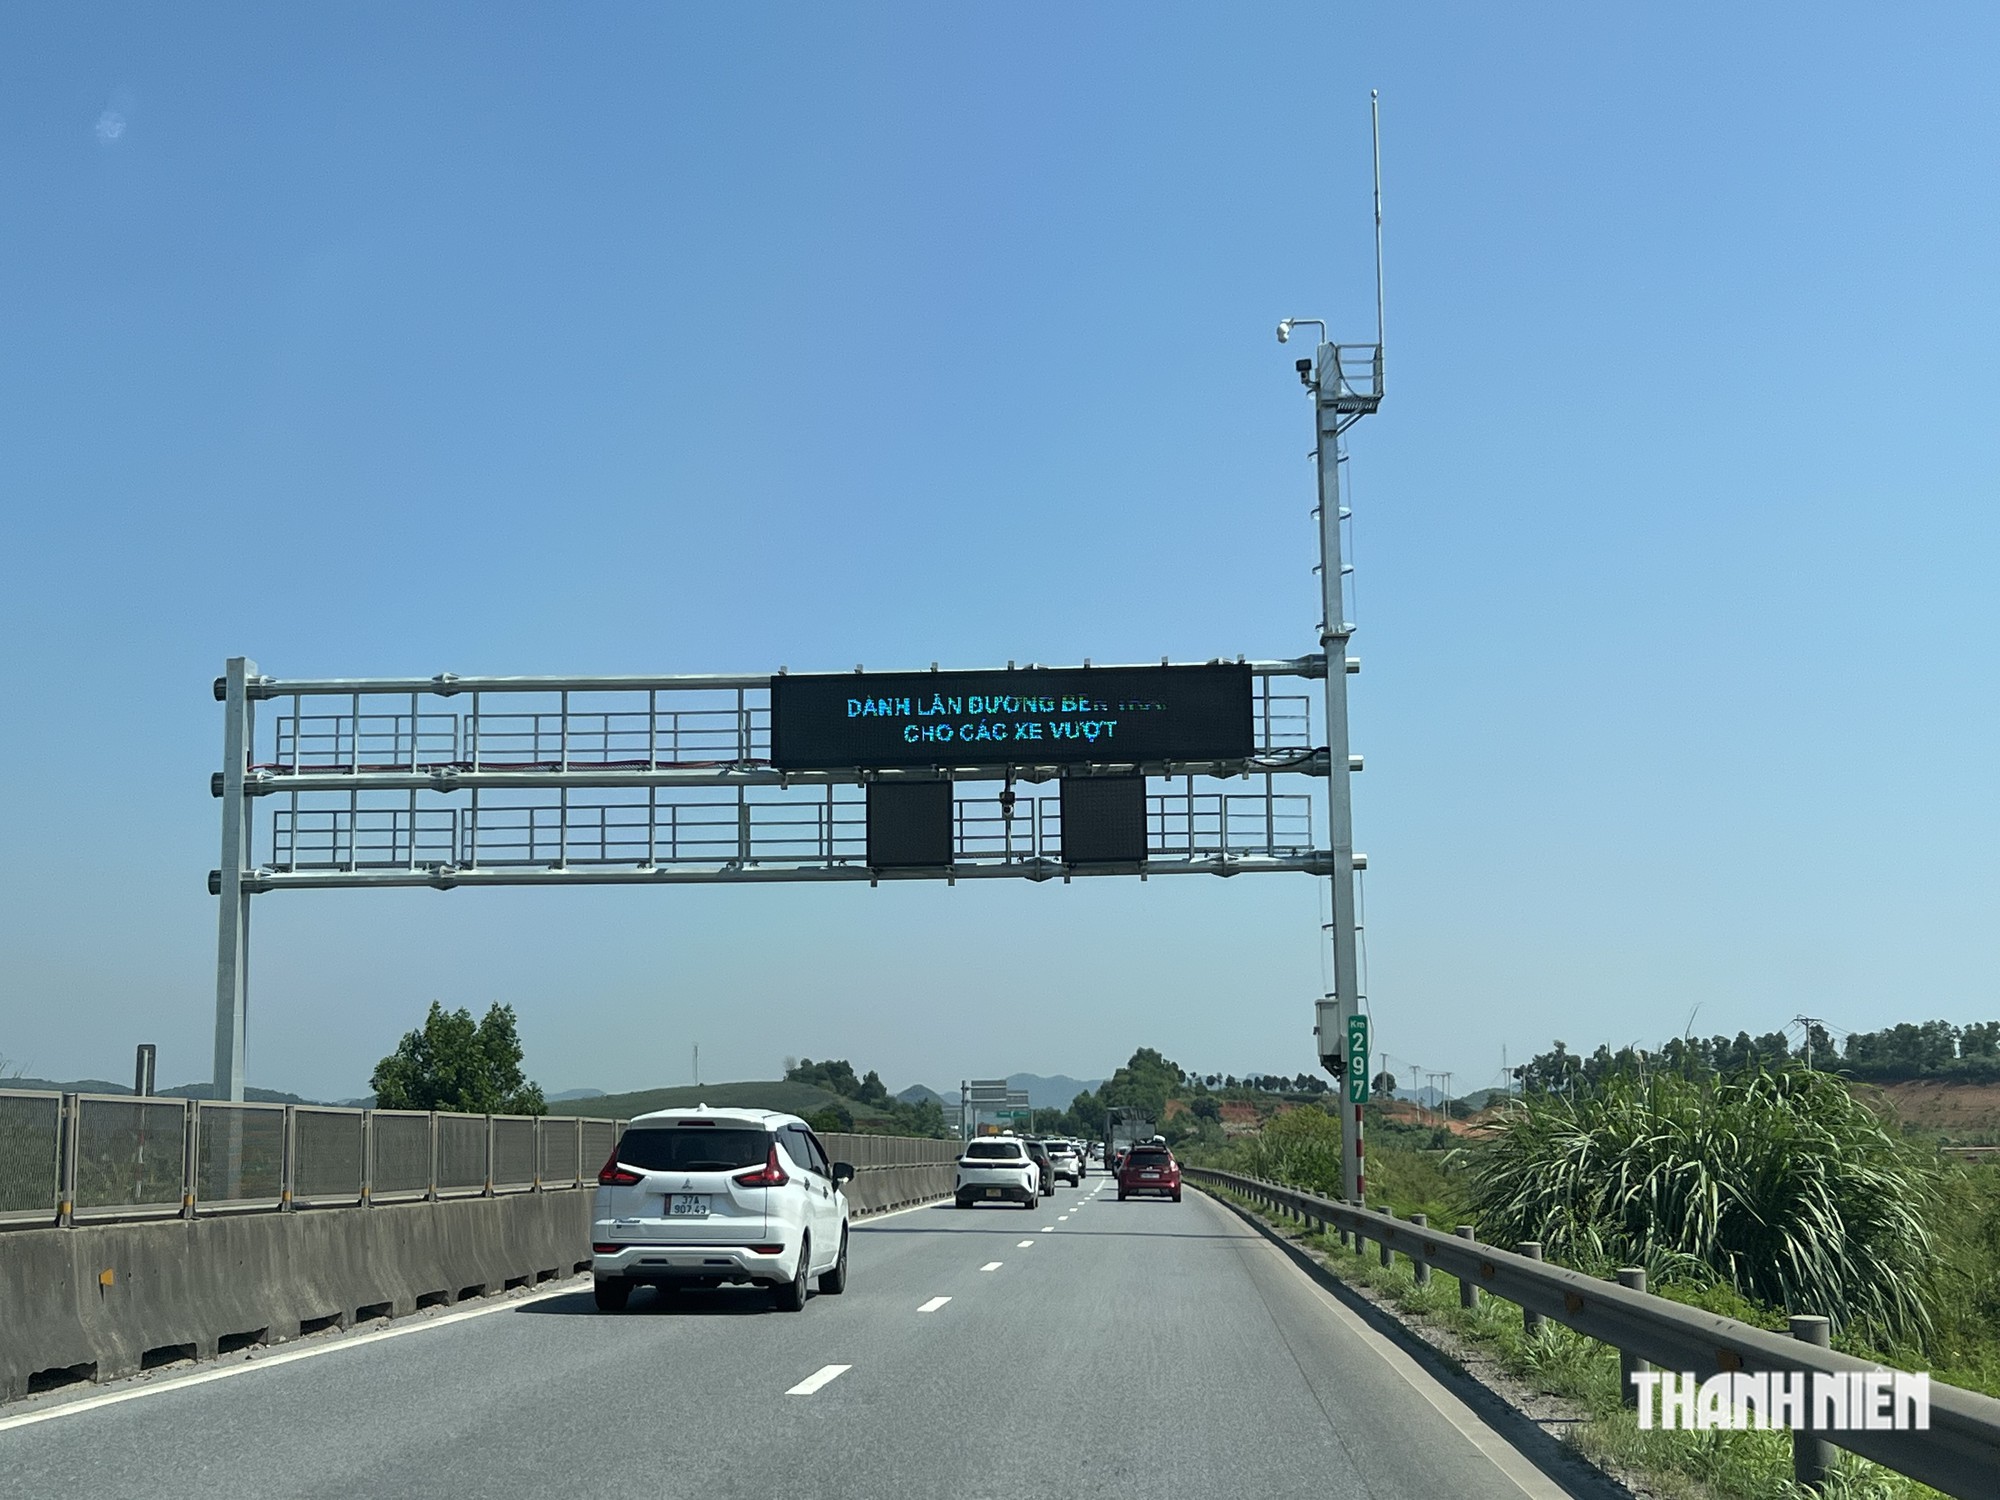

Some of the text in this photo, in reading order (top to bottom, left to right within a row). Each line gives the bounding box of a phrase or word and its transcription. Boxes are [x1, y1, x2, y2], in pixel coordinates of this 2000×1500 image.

[903, 723, 954, 743] CHO
[959, 718, 1008, 742] CÁC
[1014, 722, 1043, 741] XE
[1350, 1020, 1366, 1029] Km
